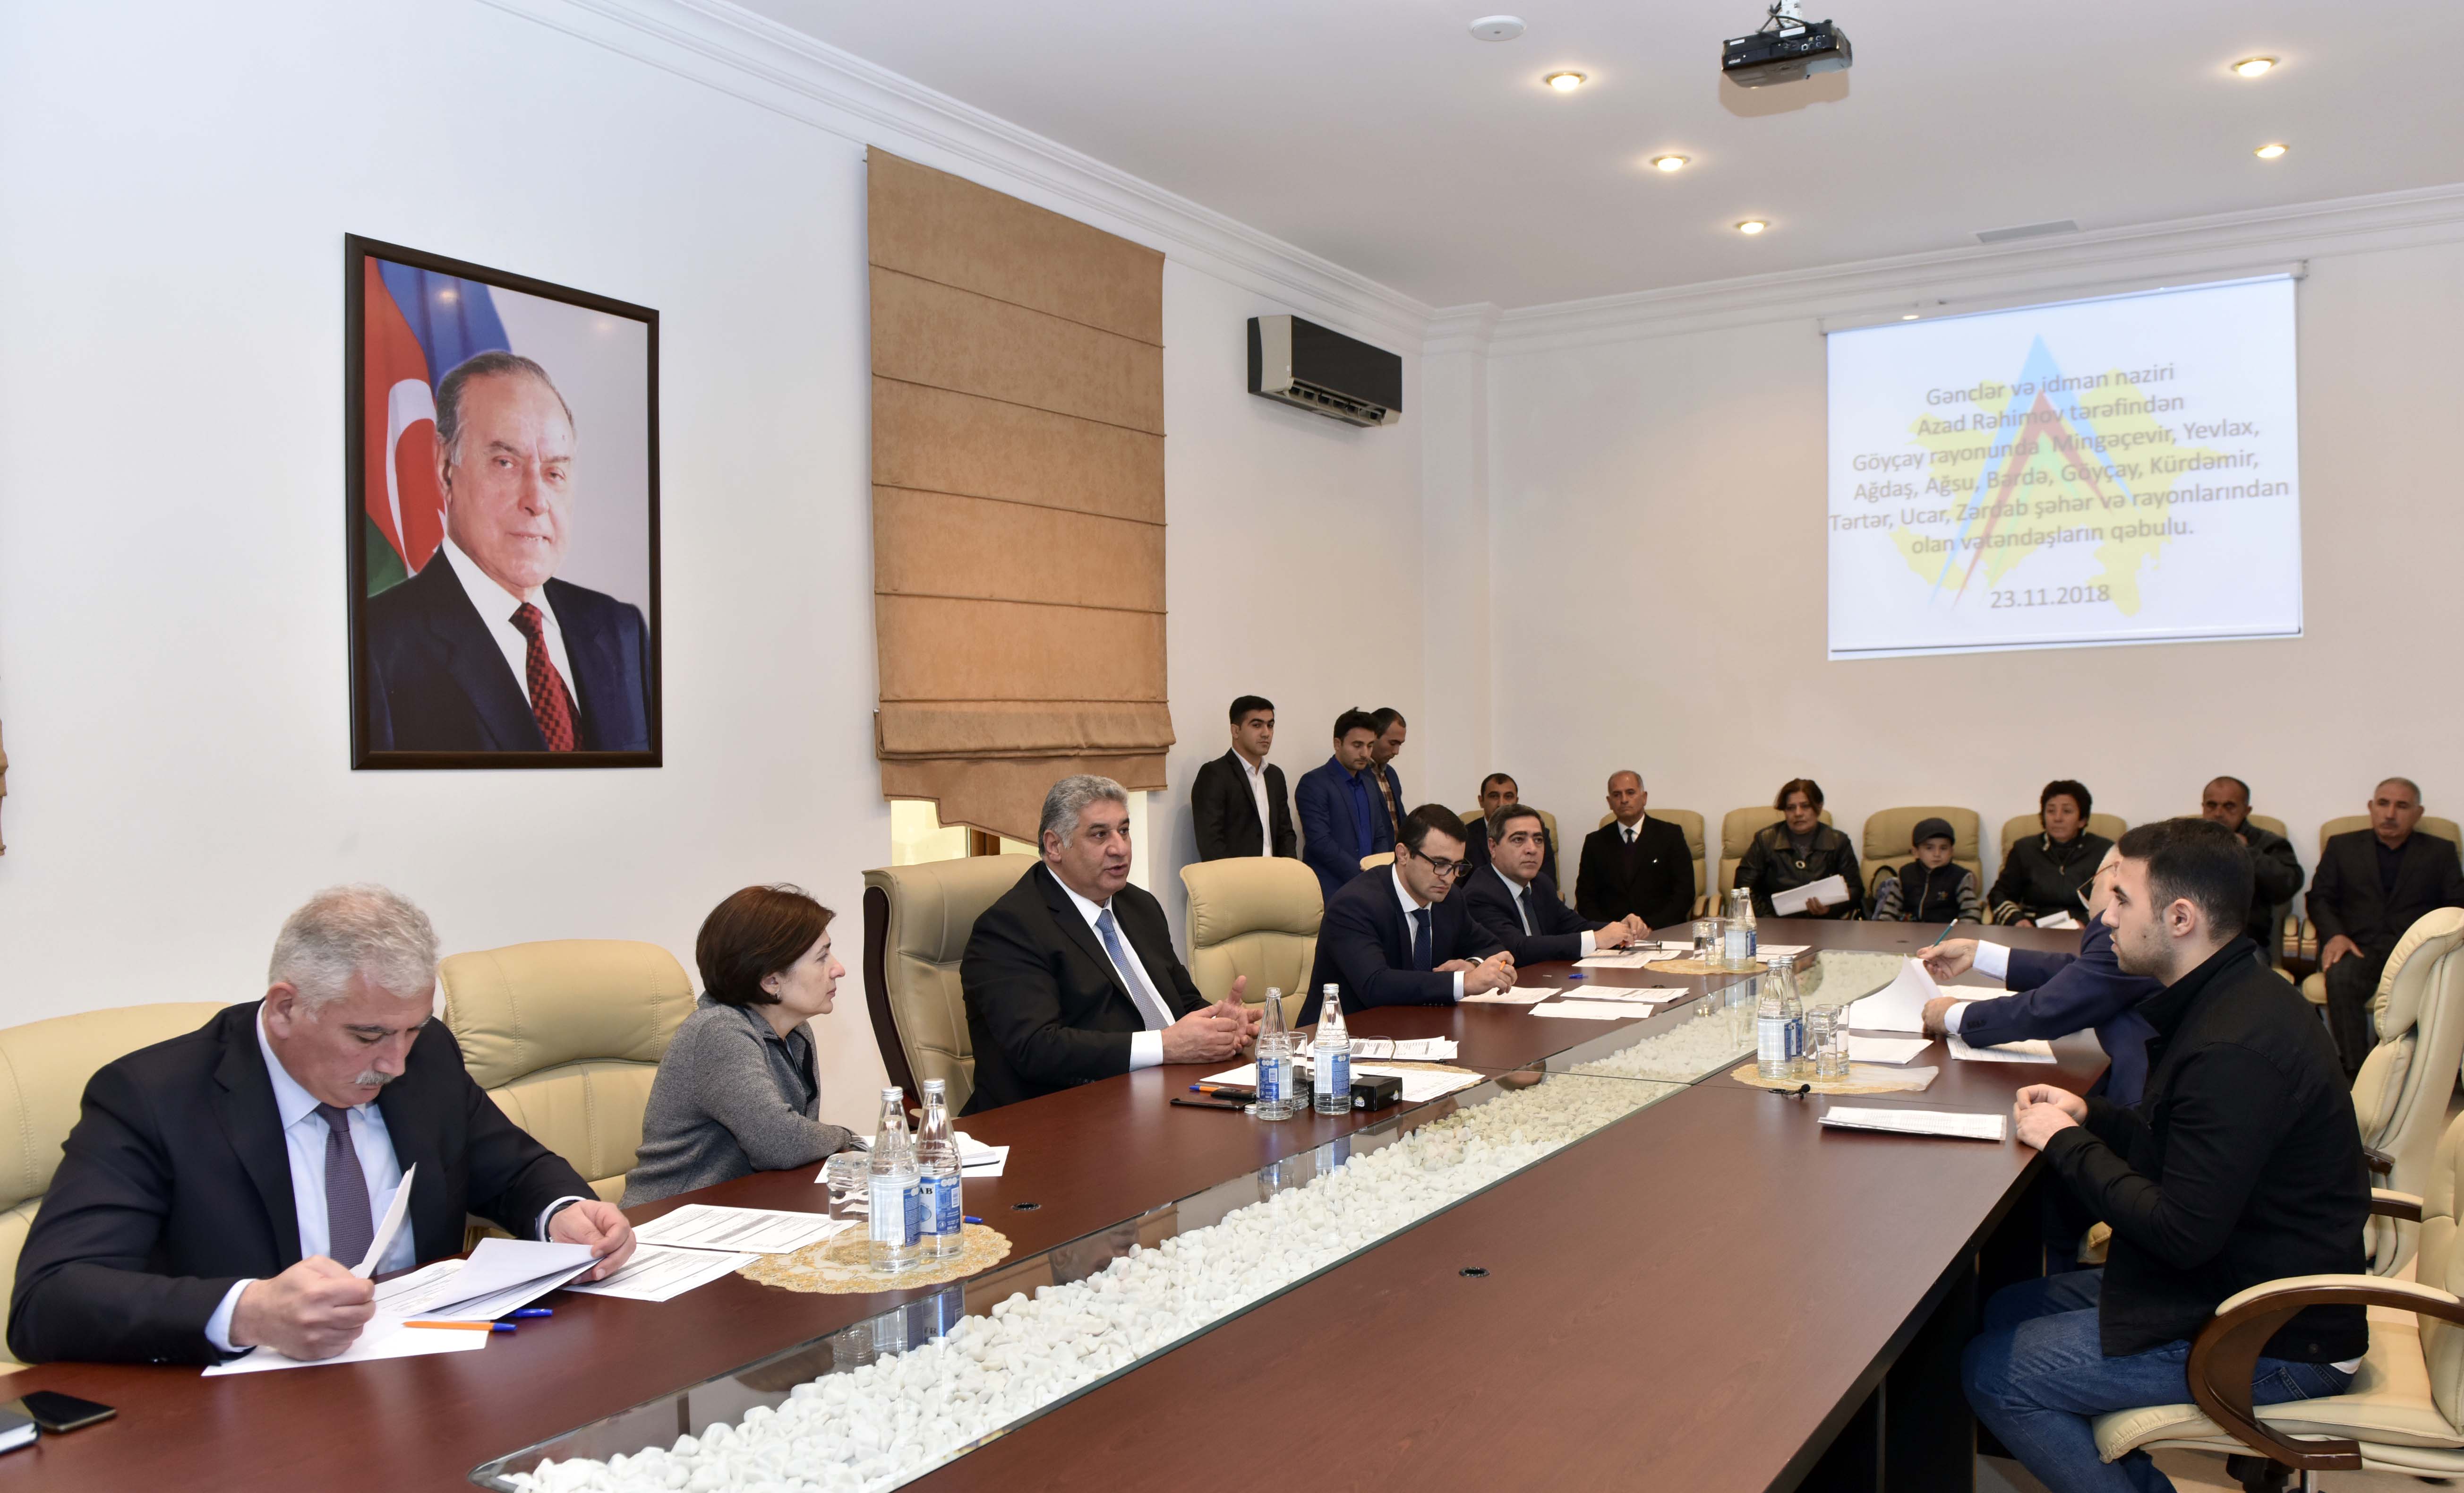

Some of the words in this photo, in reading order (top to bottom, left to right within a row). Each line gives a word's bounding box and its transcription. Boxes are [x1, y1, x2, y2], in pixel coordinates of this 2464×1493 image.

[1926, 379, 2004, 405] Gənclər
[2011, 381, 2034, 396] və
[2041, 372, 2108, 394] idman
[2114, 362, 2174, 386] naziri
[1917, 414, 1965, 437] Azad
[1973, 409, 2063, 430] Rəhimov
[2070, 395, 2184, 420] tərəfindən
[1852, 451, 1924, 473] Göyçay
[1930, 440, 2039, 466] rayonunda
[2053, 426, 2176, 453] Mingəçevir,
[2183, 419, 2260, 440] Yevlax,
[1854, 481, 1918, 503] Ağdaş,
[1925, 475, 1980, 497] Ağsu,
[1987, 467, 2053, 489] Bərdə,
[2062, 462, 2143, 483] Göyçay,
[2150, 449, 2259, 475] Kürdəmir,
[1830, 513, 1893, 531] Tərtər,
[1900, 508, 1951, 526] Ucar,
[1957, 498, 2028, 521] Zərdab
[2035, 495, 2094, 520] şəhər
[2101, 494, 2125, 509] və
[2132, 479, 2289, 509] rayonlarından
[1912, 536, 1954, 554] olan
[1961, 526, 2103, 551] vətəndaşların
[2111, 517, 2194, 543] qəbulu.
[1990, 584, 2110, 609] 23.11.2018
